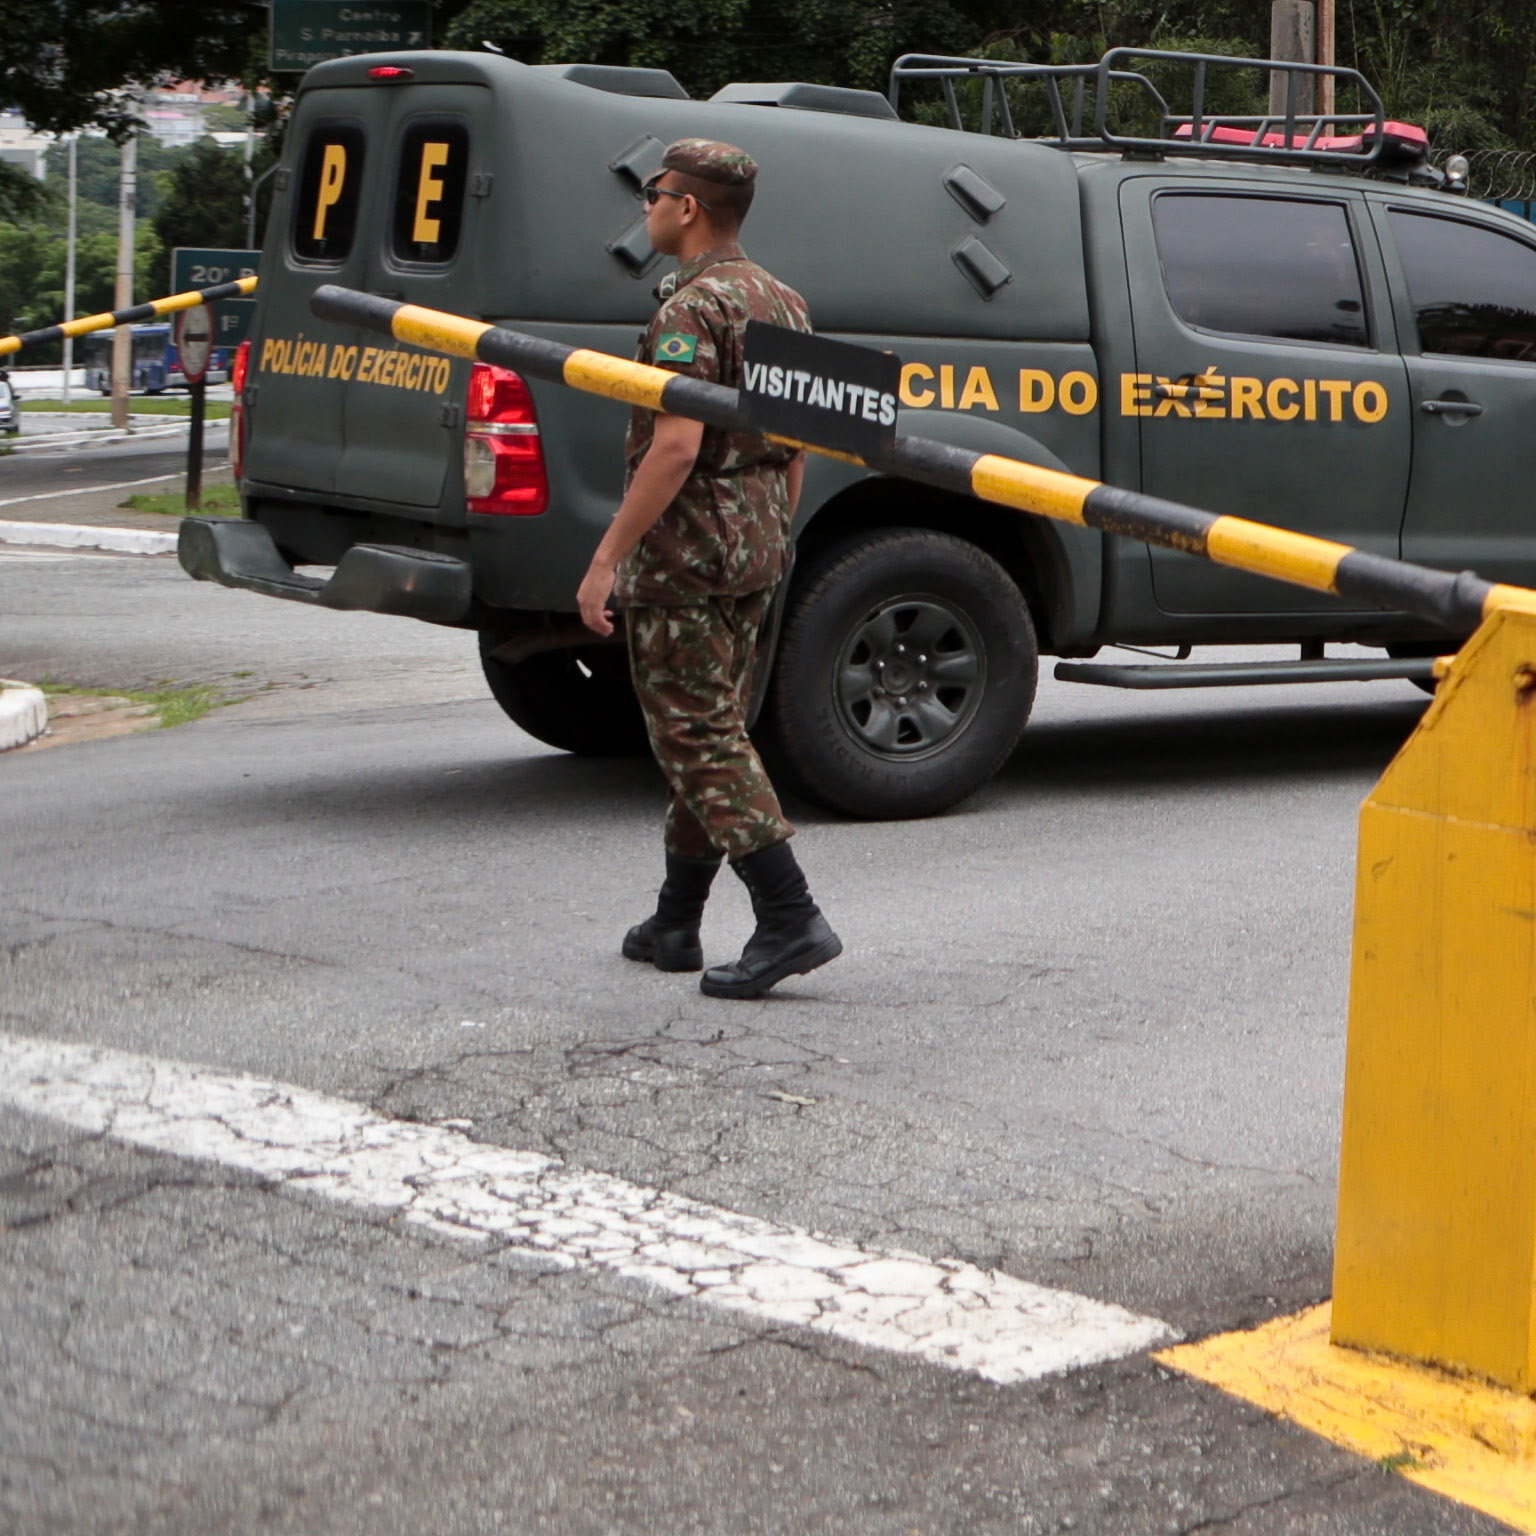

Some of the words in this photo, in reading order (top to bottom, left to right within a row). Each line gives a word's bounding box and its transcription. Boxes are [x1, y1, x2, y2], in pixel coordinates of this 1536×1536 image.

[313, 144, 346, 240] P
[412, 142, 449, 243] E
[259, 333, 327, 378] POLÍCIA
[327, 344, 357, 382] DO
[356, 343, 450, 395] EXÉRCITO
[743, 360, 897, 426] VISITANTES
[1019, 368, 1098, 415] DO
[1120, 366, 1389, 423] EXÉRCITO
